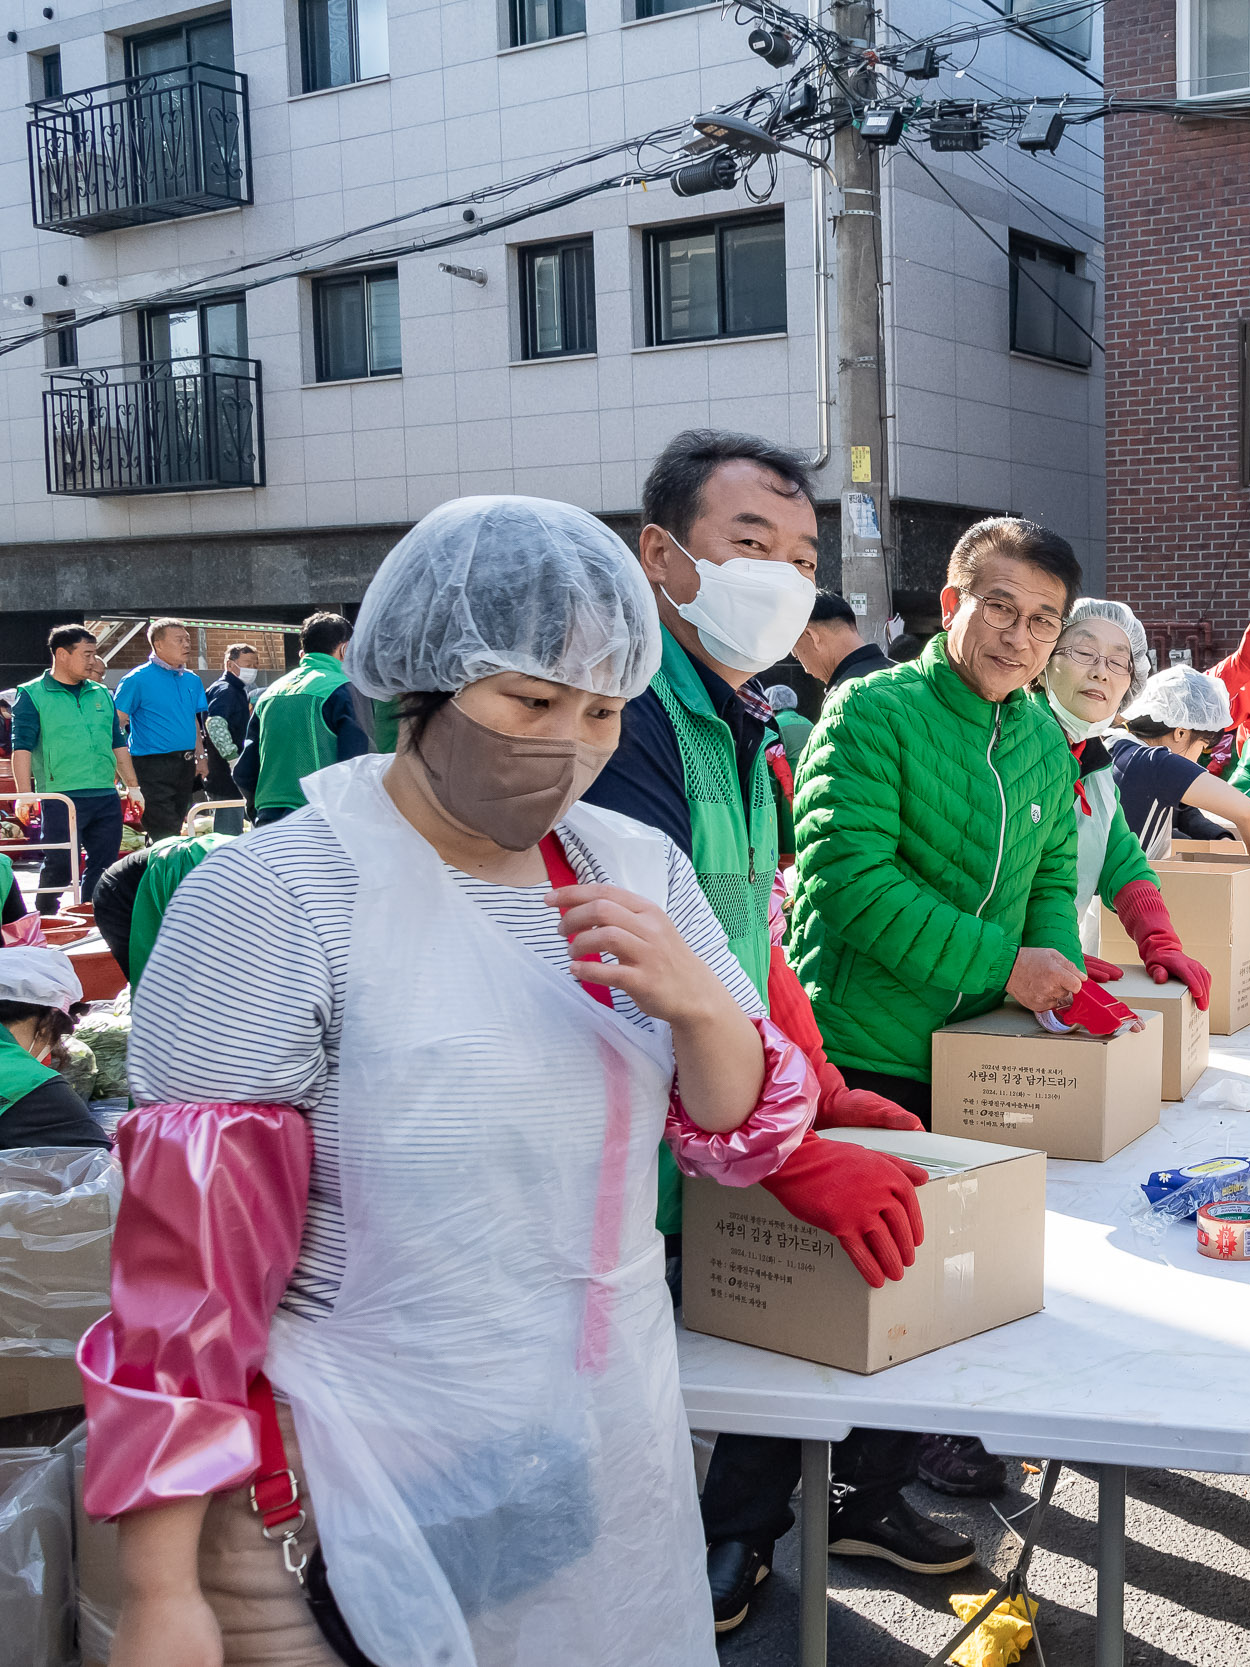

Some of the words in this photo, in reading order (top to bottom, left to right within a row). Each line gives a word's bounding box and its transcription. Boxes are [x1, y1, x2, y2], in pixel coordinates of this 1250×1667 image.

[967, 1070, 997, 1083] 사랑의
[1001, 1073, 1022, 1085] 김장
[1026, 1075, 1077, 1089] 담가드리기
[715, 1219, 746, 1240] 사랑의
[750, 1226, 773, 1246] 김장
[777, 1233, 834, 1259] 담가드리기
